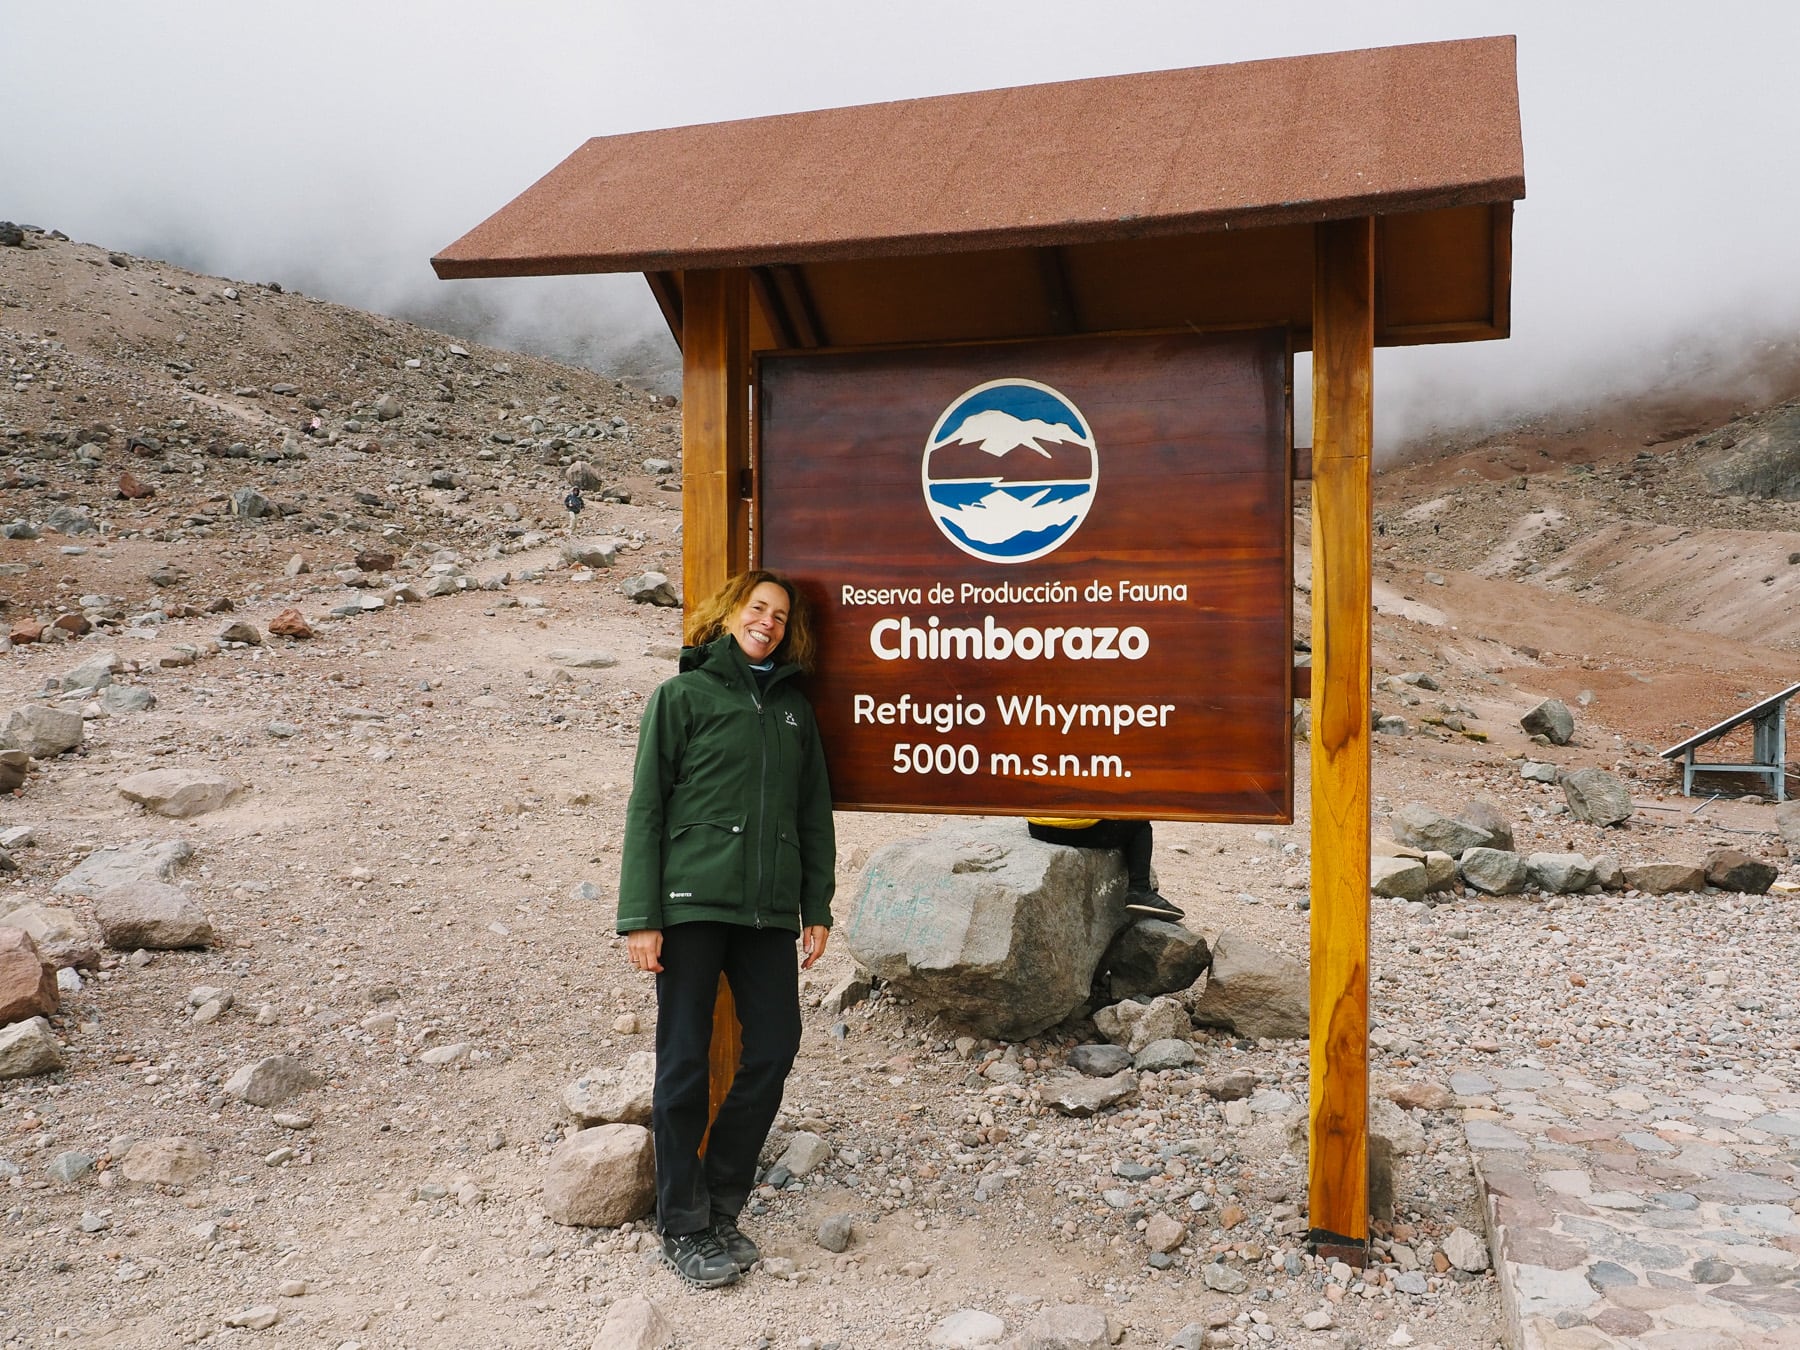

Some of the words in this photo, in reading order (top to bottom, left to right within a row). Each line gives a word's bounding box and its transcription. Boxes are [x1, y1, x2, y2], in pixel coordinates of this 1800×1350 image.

[842, 584, 921, 605] Reserva
[928, 582, 955, 605] de
[960, 581, 1078, 604] Producción
[1084, 579, 1113, 602] de
[1119, 580, 1188, 602] Fauna
[869, 615, 1150, 661] Chimborazo
[853, 694, 986, 733] Refugio
[996, 695, 1176, 735] Whymper
[892, 743, 980, 775] 5000
[990, 753, 1132, 778] m.s.n.m.
